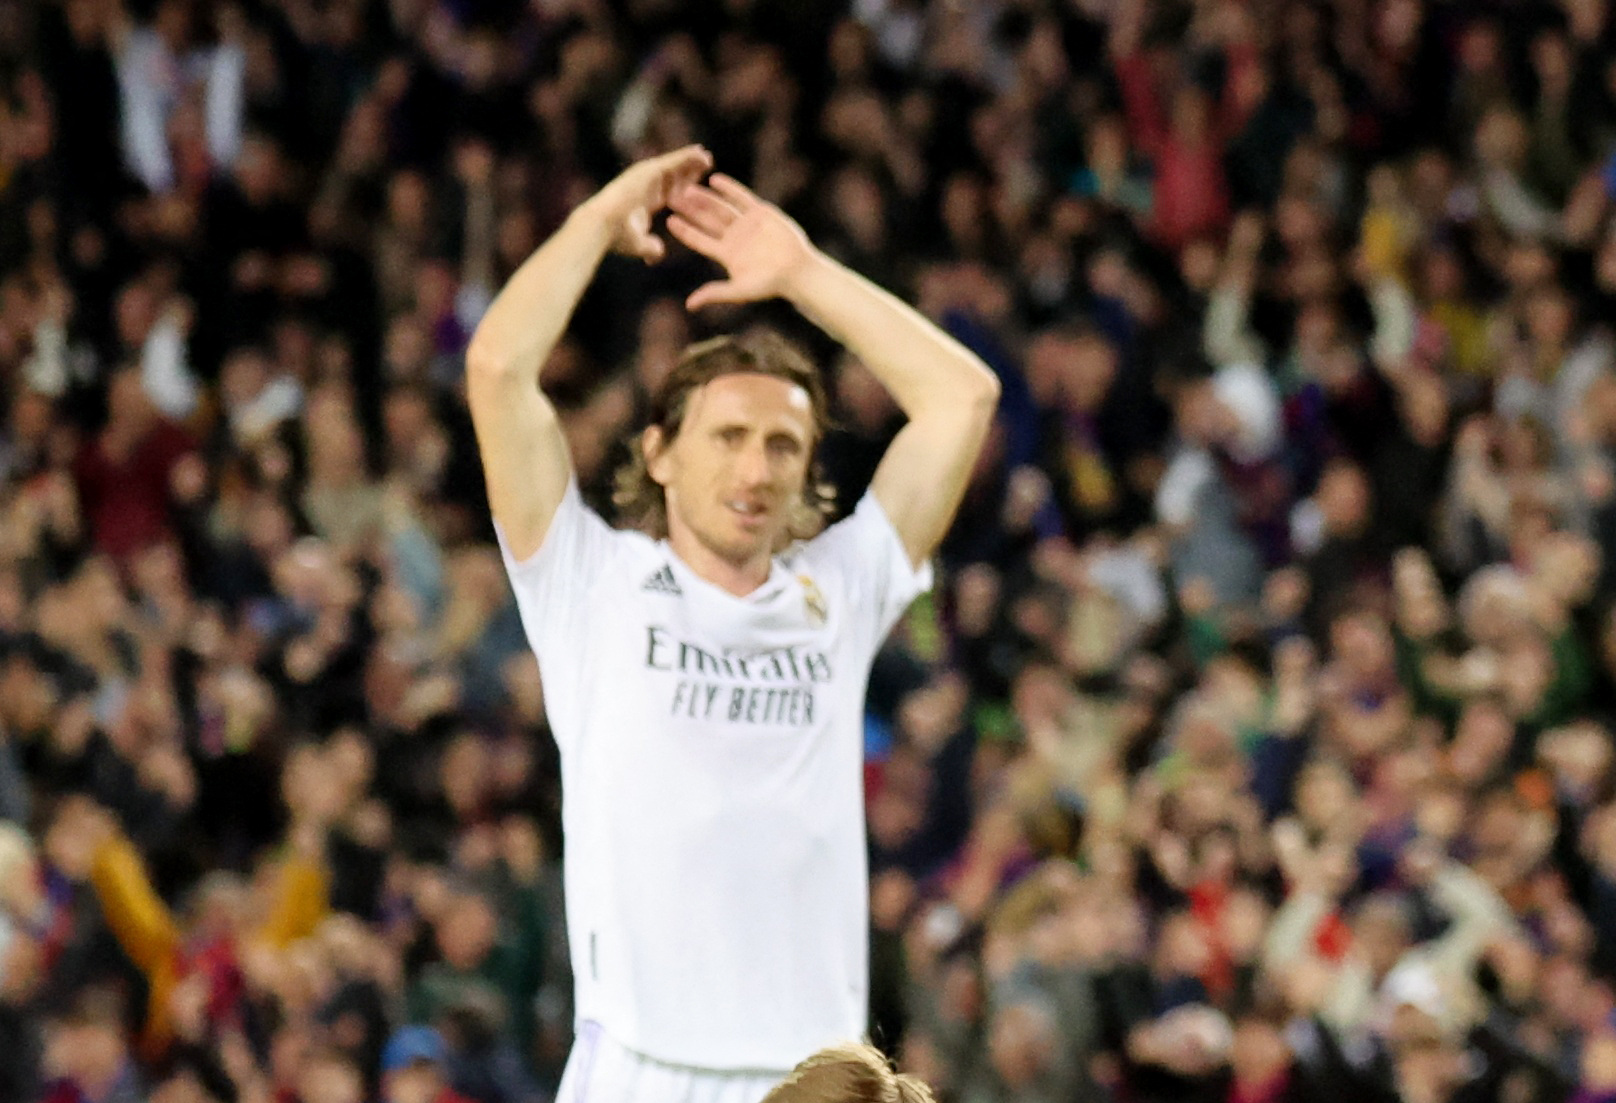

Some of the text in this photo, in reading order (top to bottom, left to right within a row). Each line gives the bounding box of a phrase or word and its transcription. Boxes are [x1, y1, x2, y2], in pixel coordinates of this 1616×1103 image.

[645, 622, 833, 684] Emirates
[672, 681, 815, 725] FLY BETTER
